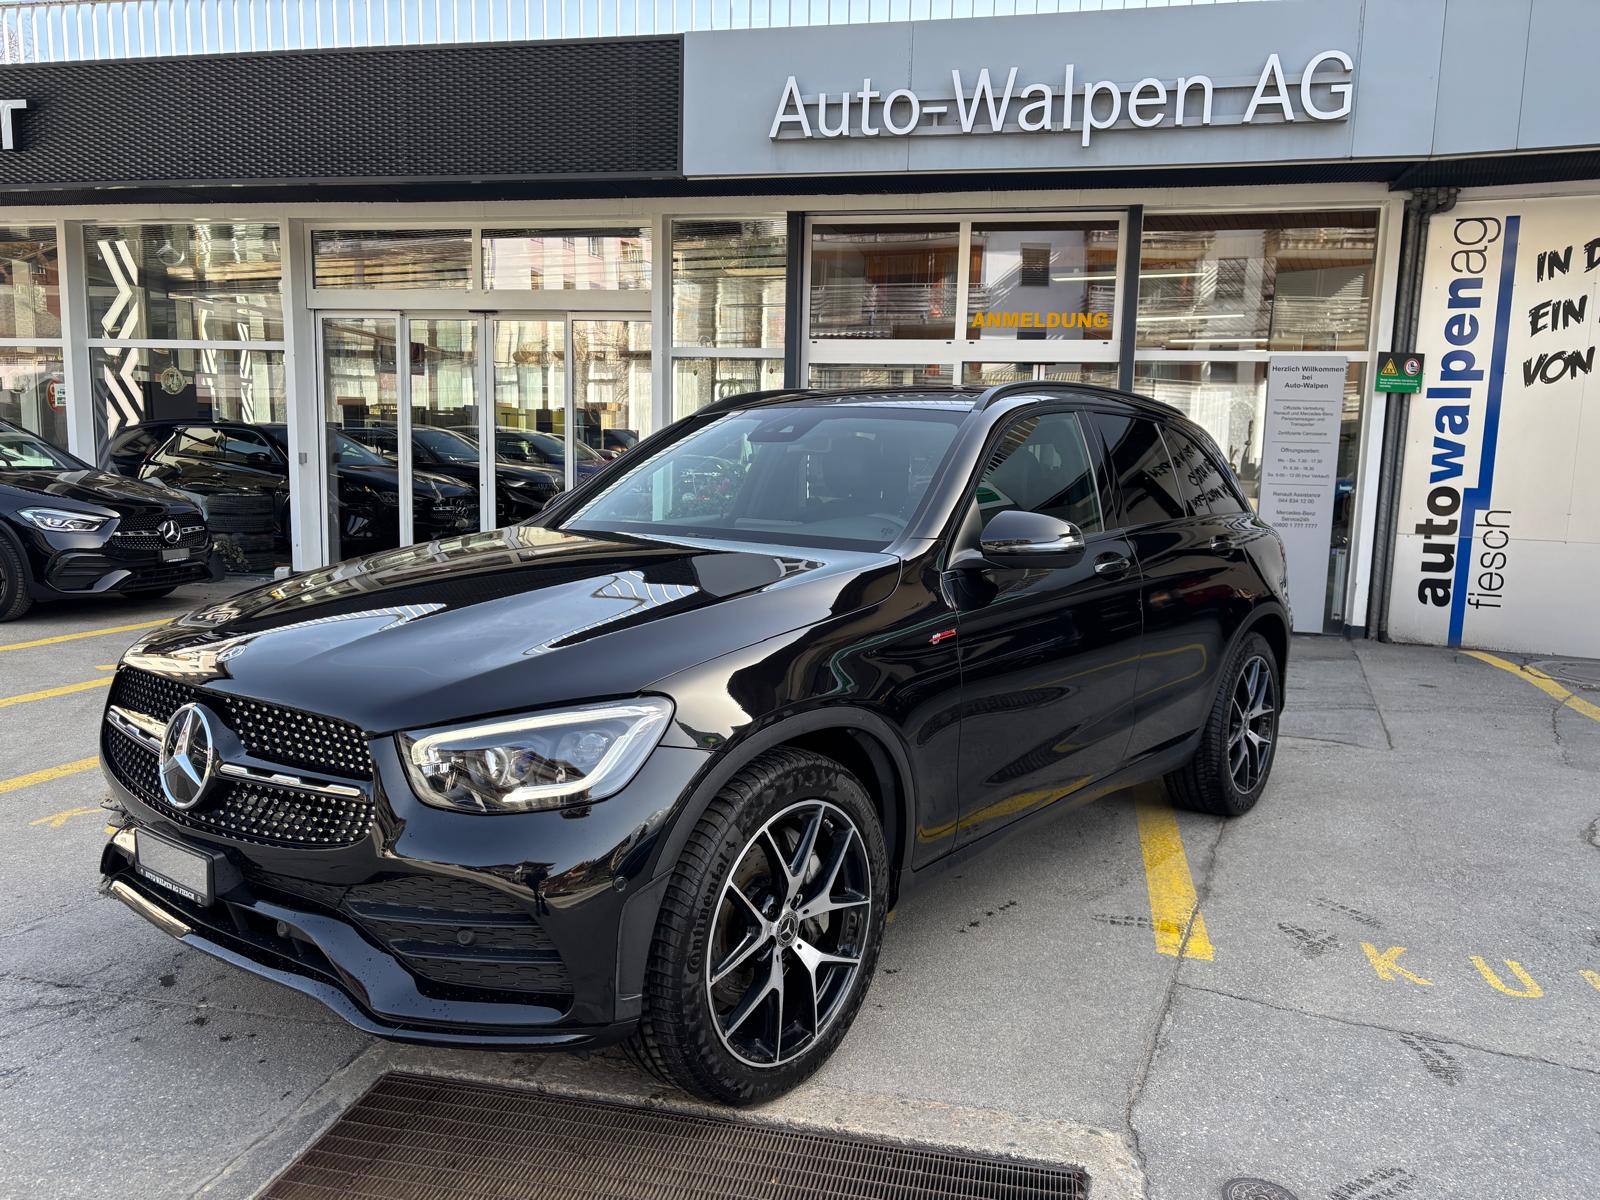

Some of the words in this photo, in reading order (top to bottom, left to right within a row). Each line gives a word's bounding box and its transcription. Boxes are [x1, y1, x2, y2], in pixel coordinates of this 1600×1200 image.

[768, 63, 1214, 148] Auto-Walpen
[1242, 49, 1354, 125] AG
[1536, 245, 1573, 283] IN
[971, 311, 1110, 329] ANMELDUNG
[1528, 294, 1588, 338] EIN
[1271, 365, 1300, 373] Herzlich
[1301, 365, 1345, 373] Willkommen
[1522, 345, 1596, 388] VON
[1467, 510, 1512, 610] fiesch
